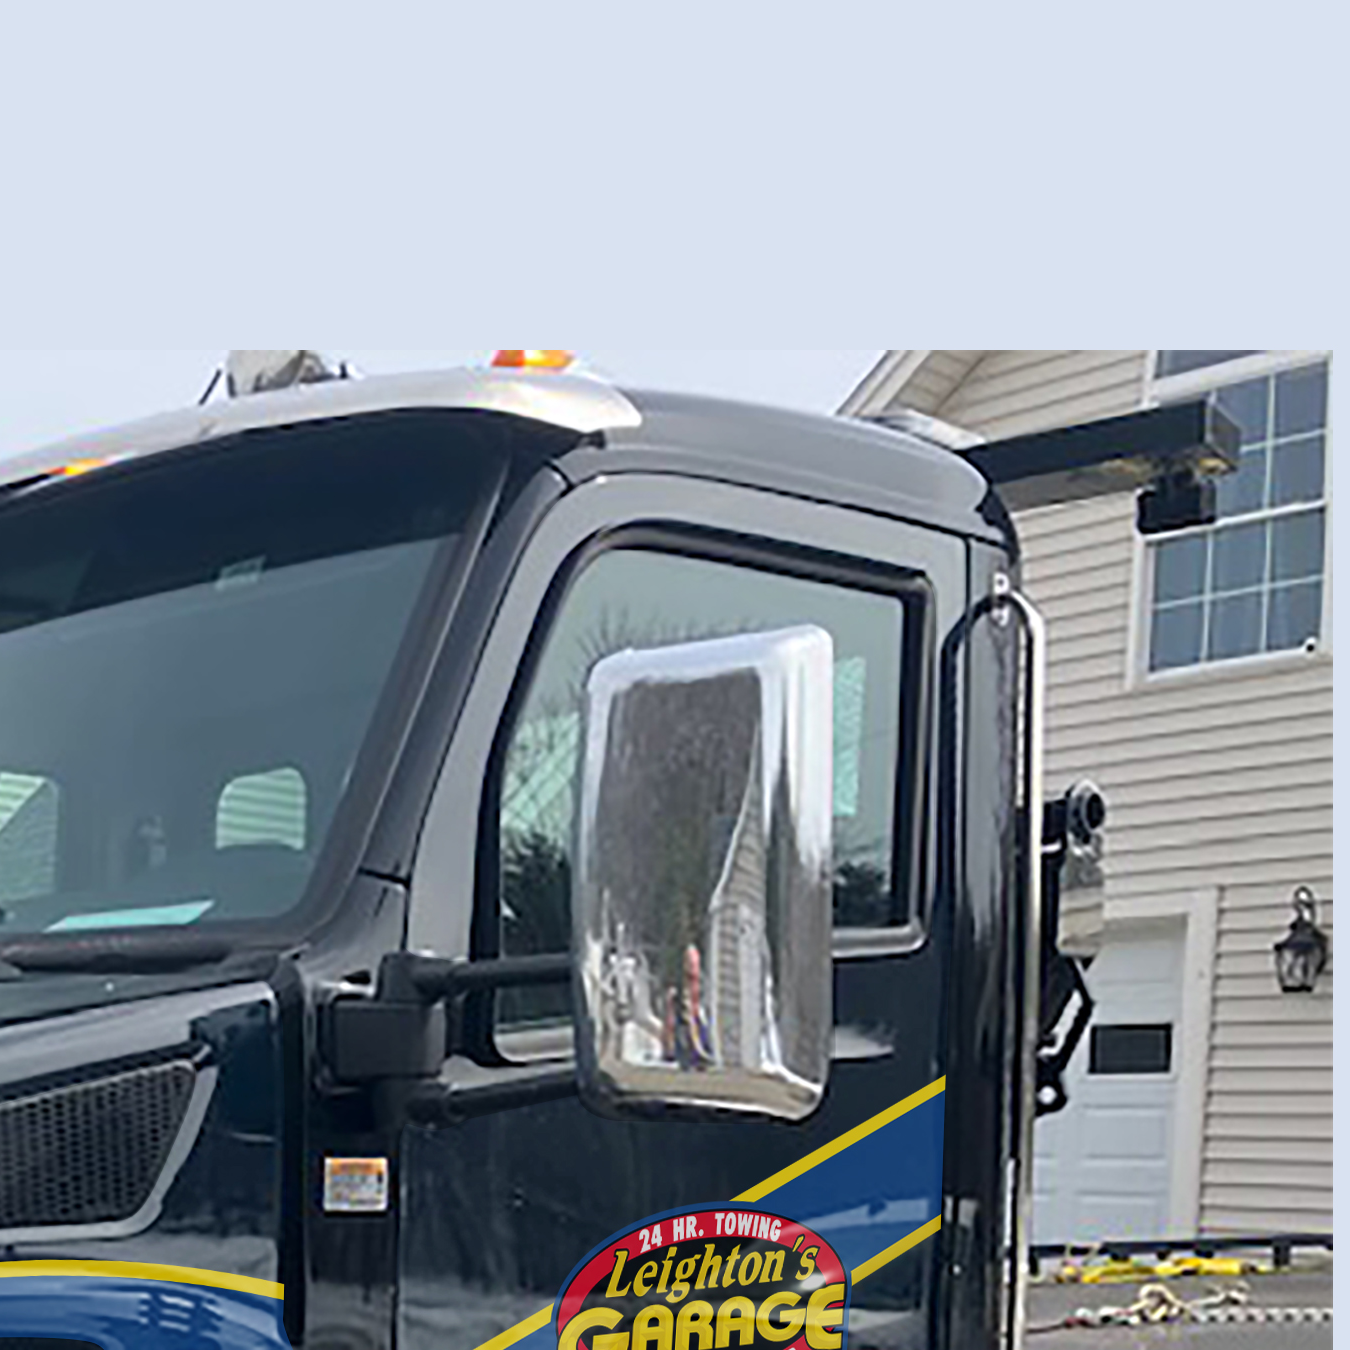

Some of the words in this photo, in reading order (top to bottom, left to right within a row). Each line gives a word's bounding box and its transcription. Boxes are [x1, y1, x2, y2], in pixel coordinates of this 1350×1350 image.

[638, 1224, 662, 1253] 24
[672, 1215, 704, 1241] HR.
[714, 1212, 782, 1242] TOWING
[605, 1235, 819, 1303] Leighton's
